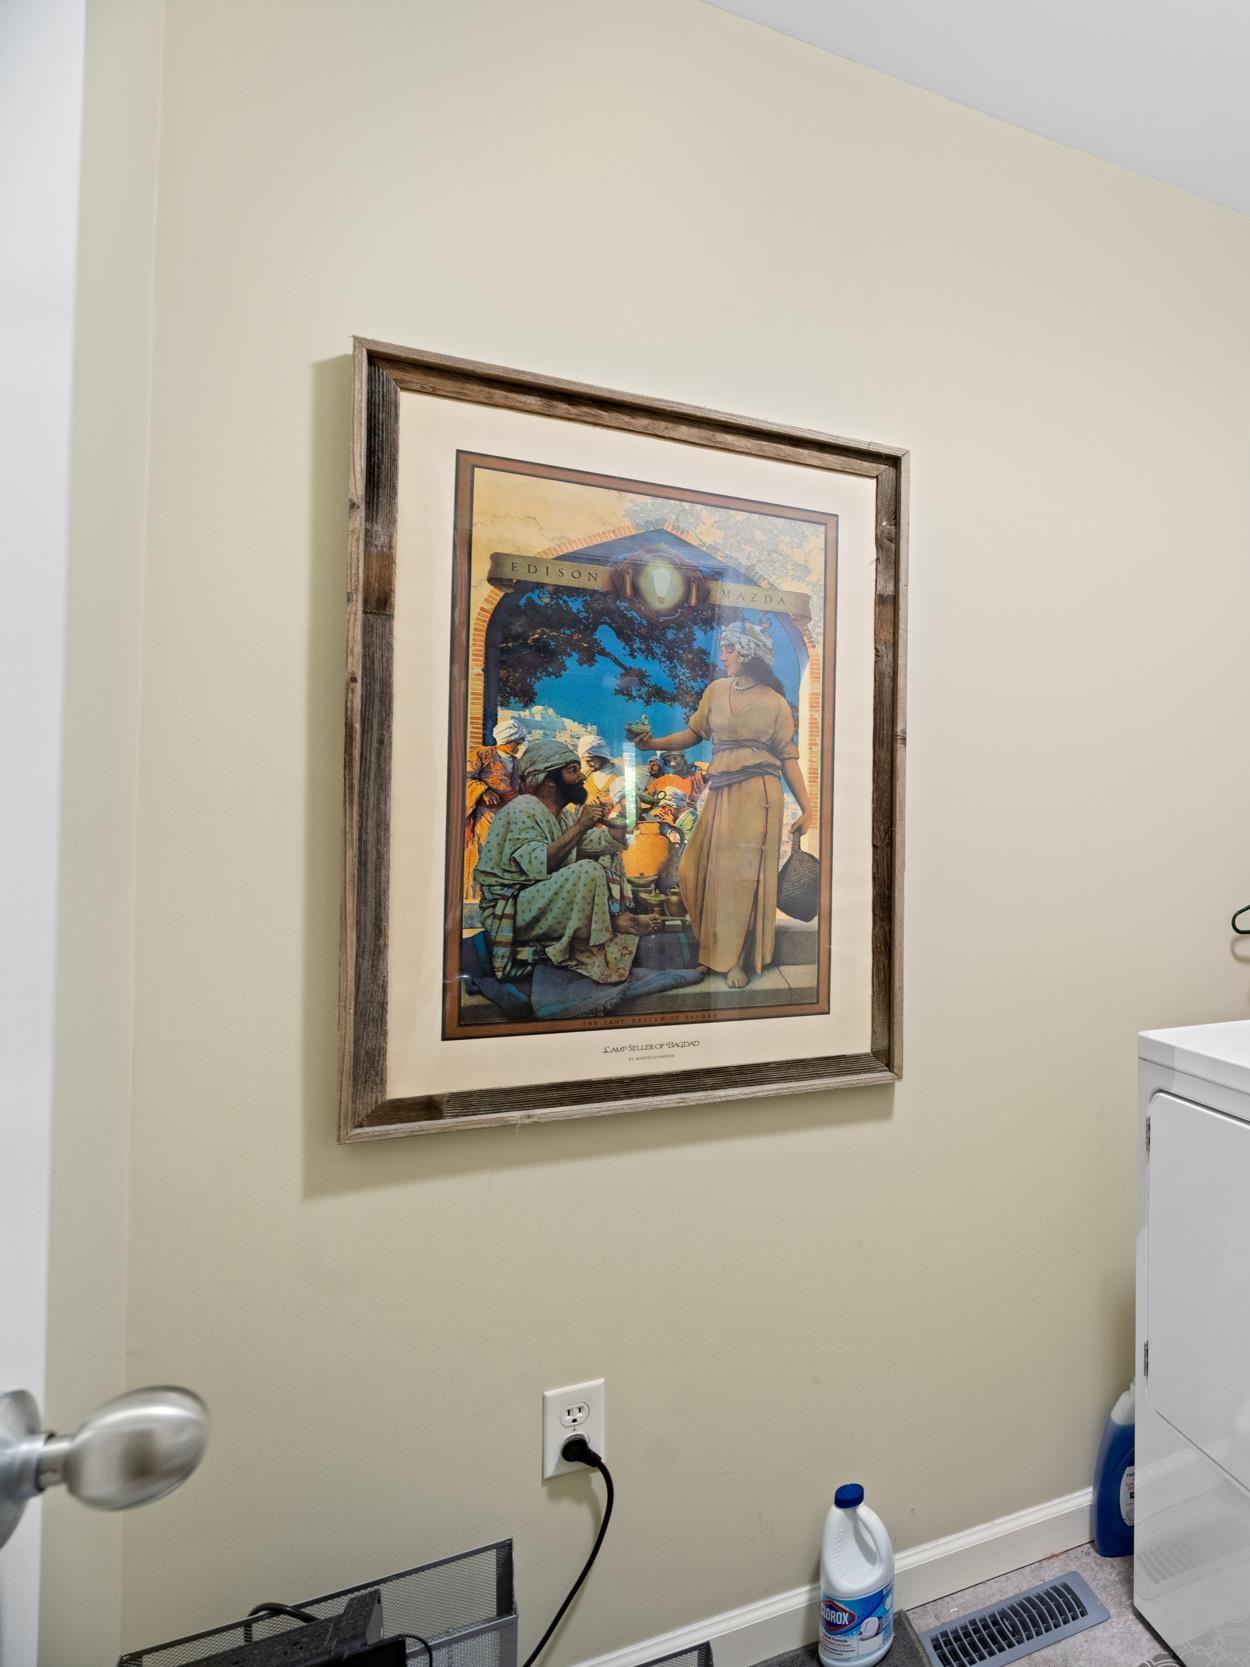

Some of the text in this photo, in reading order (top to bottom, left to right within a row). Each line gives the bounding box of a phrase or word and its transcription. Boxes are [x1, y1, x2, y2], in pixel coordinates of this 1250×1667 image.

[511, 561, 787, 606] EDISON MAZDA
[821, 1602, 849, 1625] LOROX
